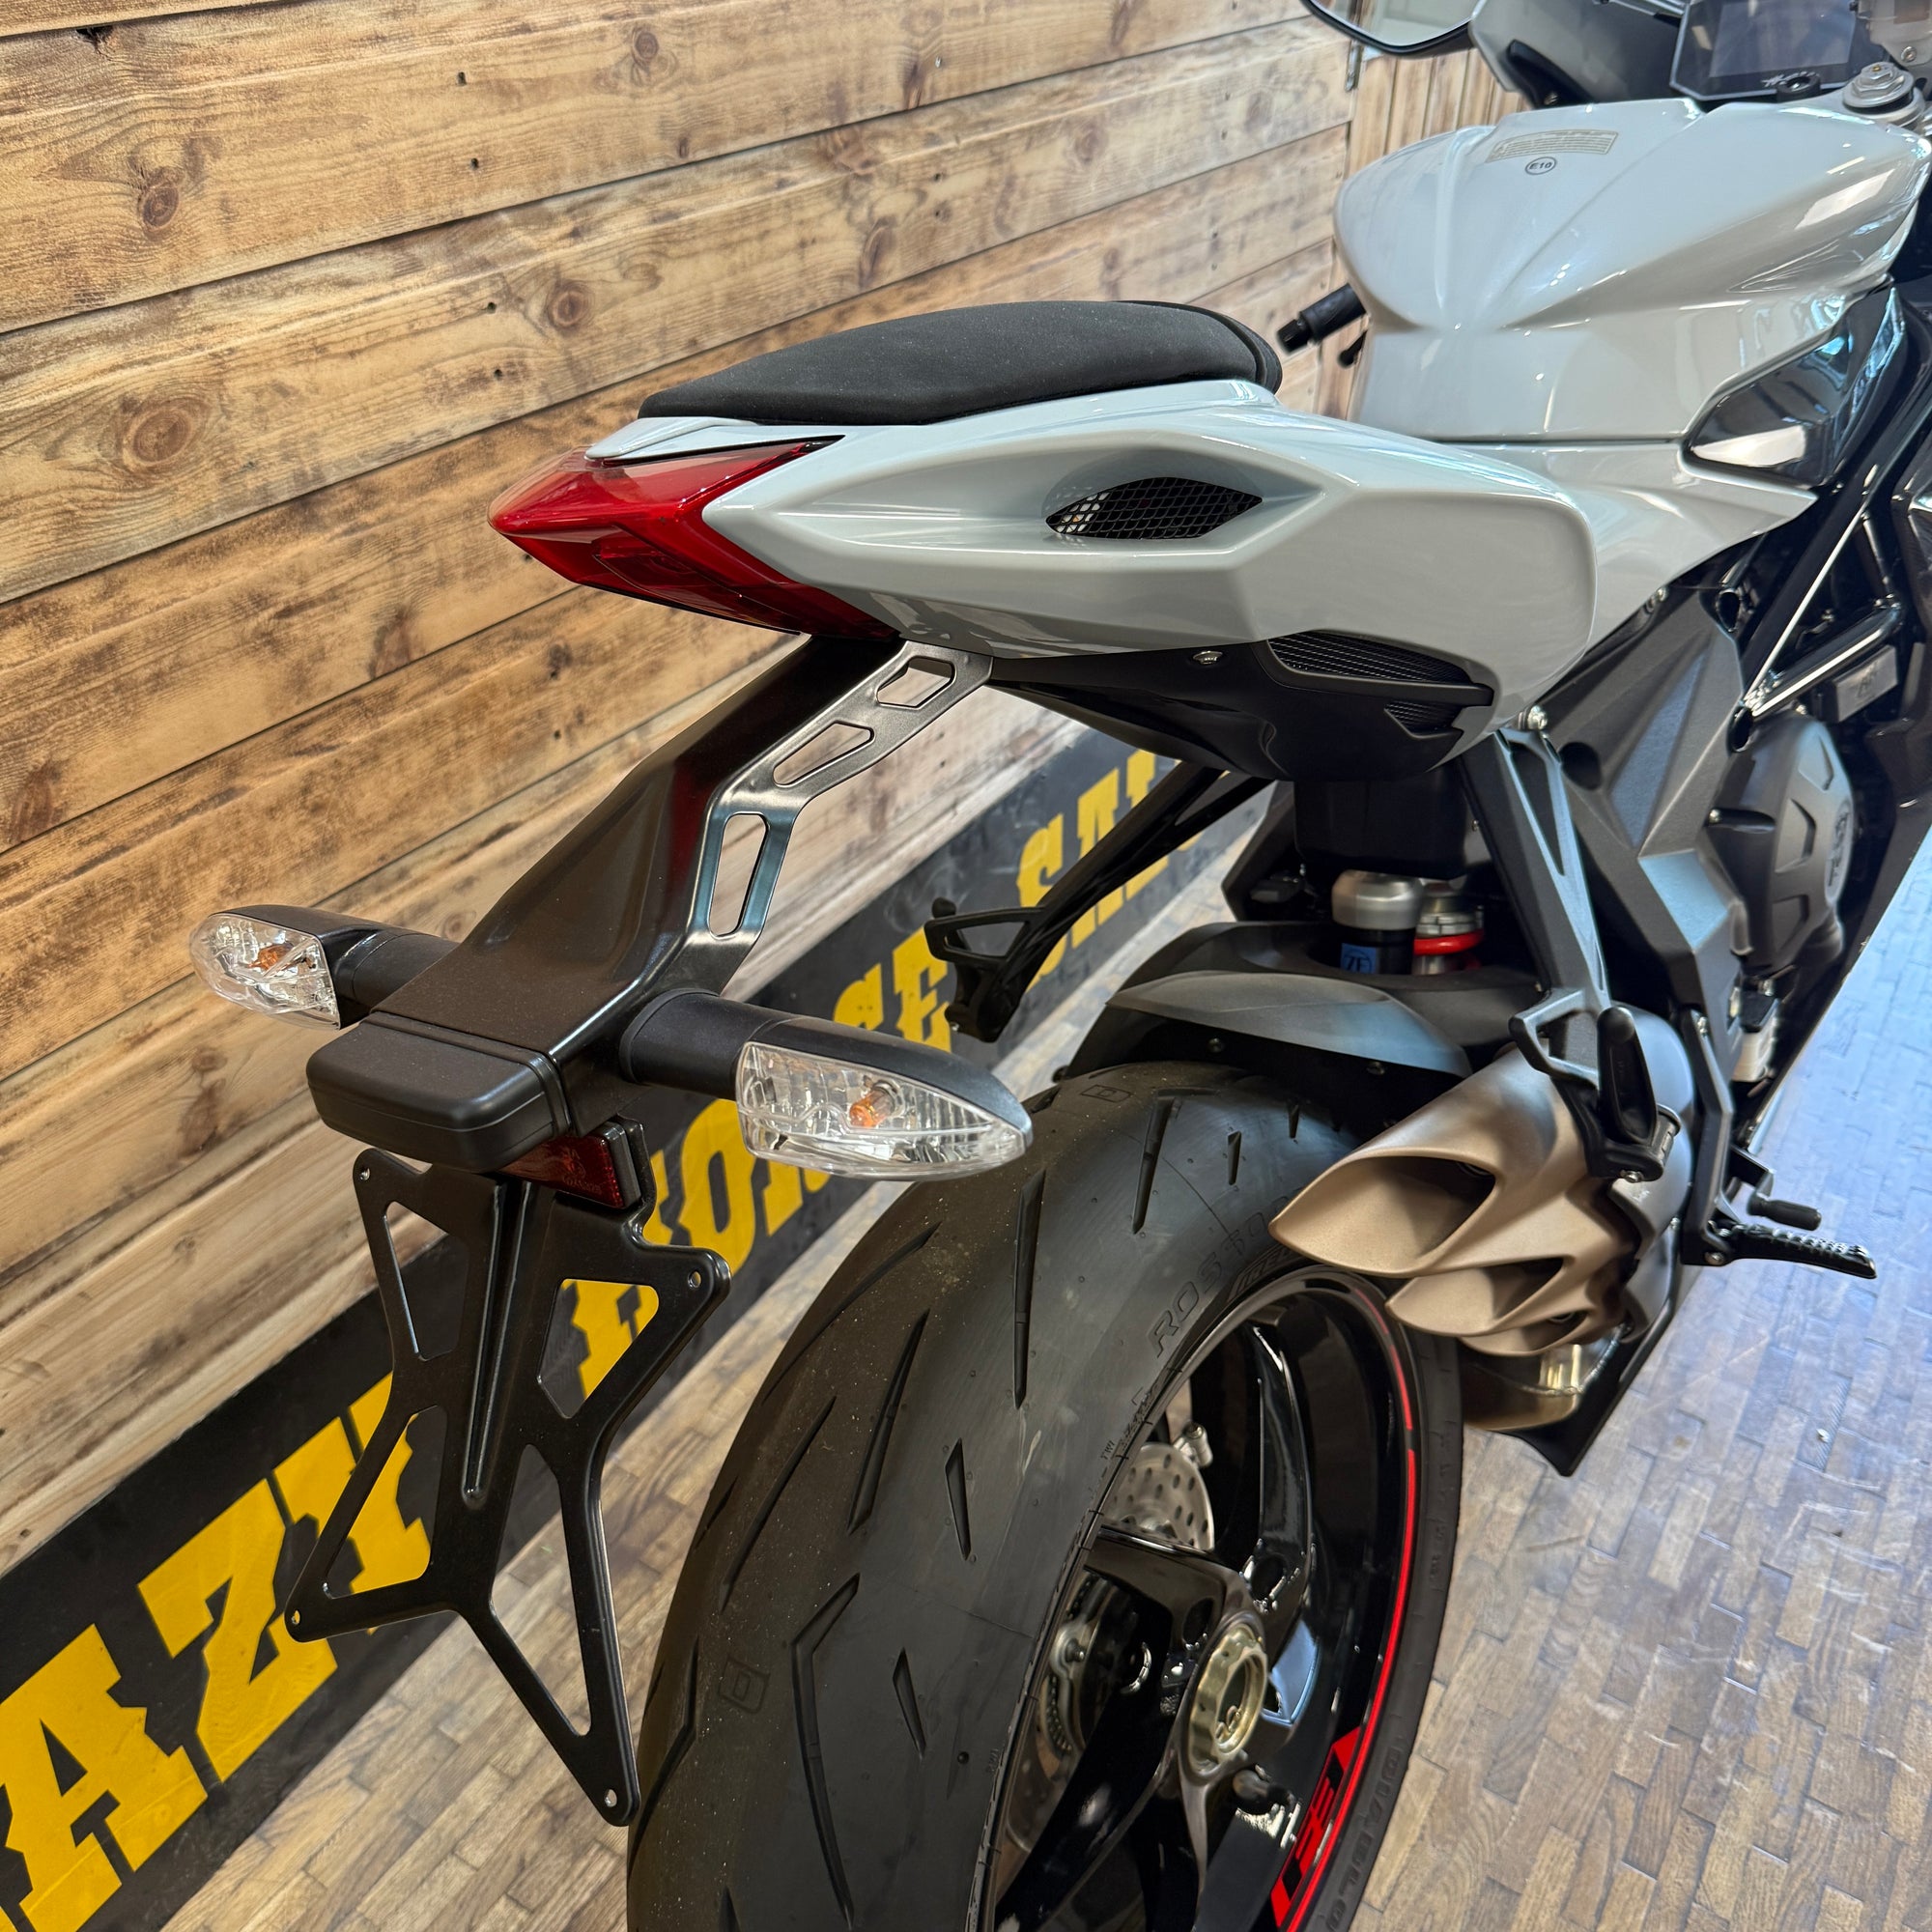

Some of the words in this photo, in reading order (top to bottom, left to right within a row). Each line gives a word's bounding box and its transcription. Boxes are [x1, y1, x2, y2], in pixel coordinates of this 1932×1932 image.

[1529, 161, 1552, 170] E10
[0, 1371, 432, 1932] AZY
[1325, 1746, 1403, 1932] DIABLO
